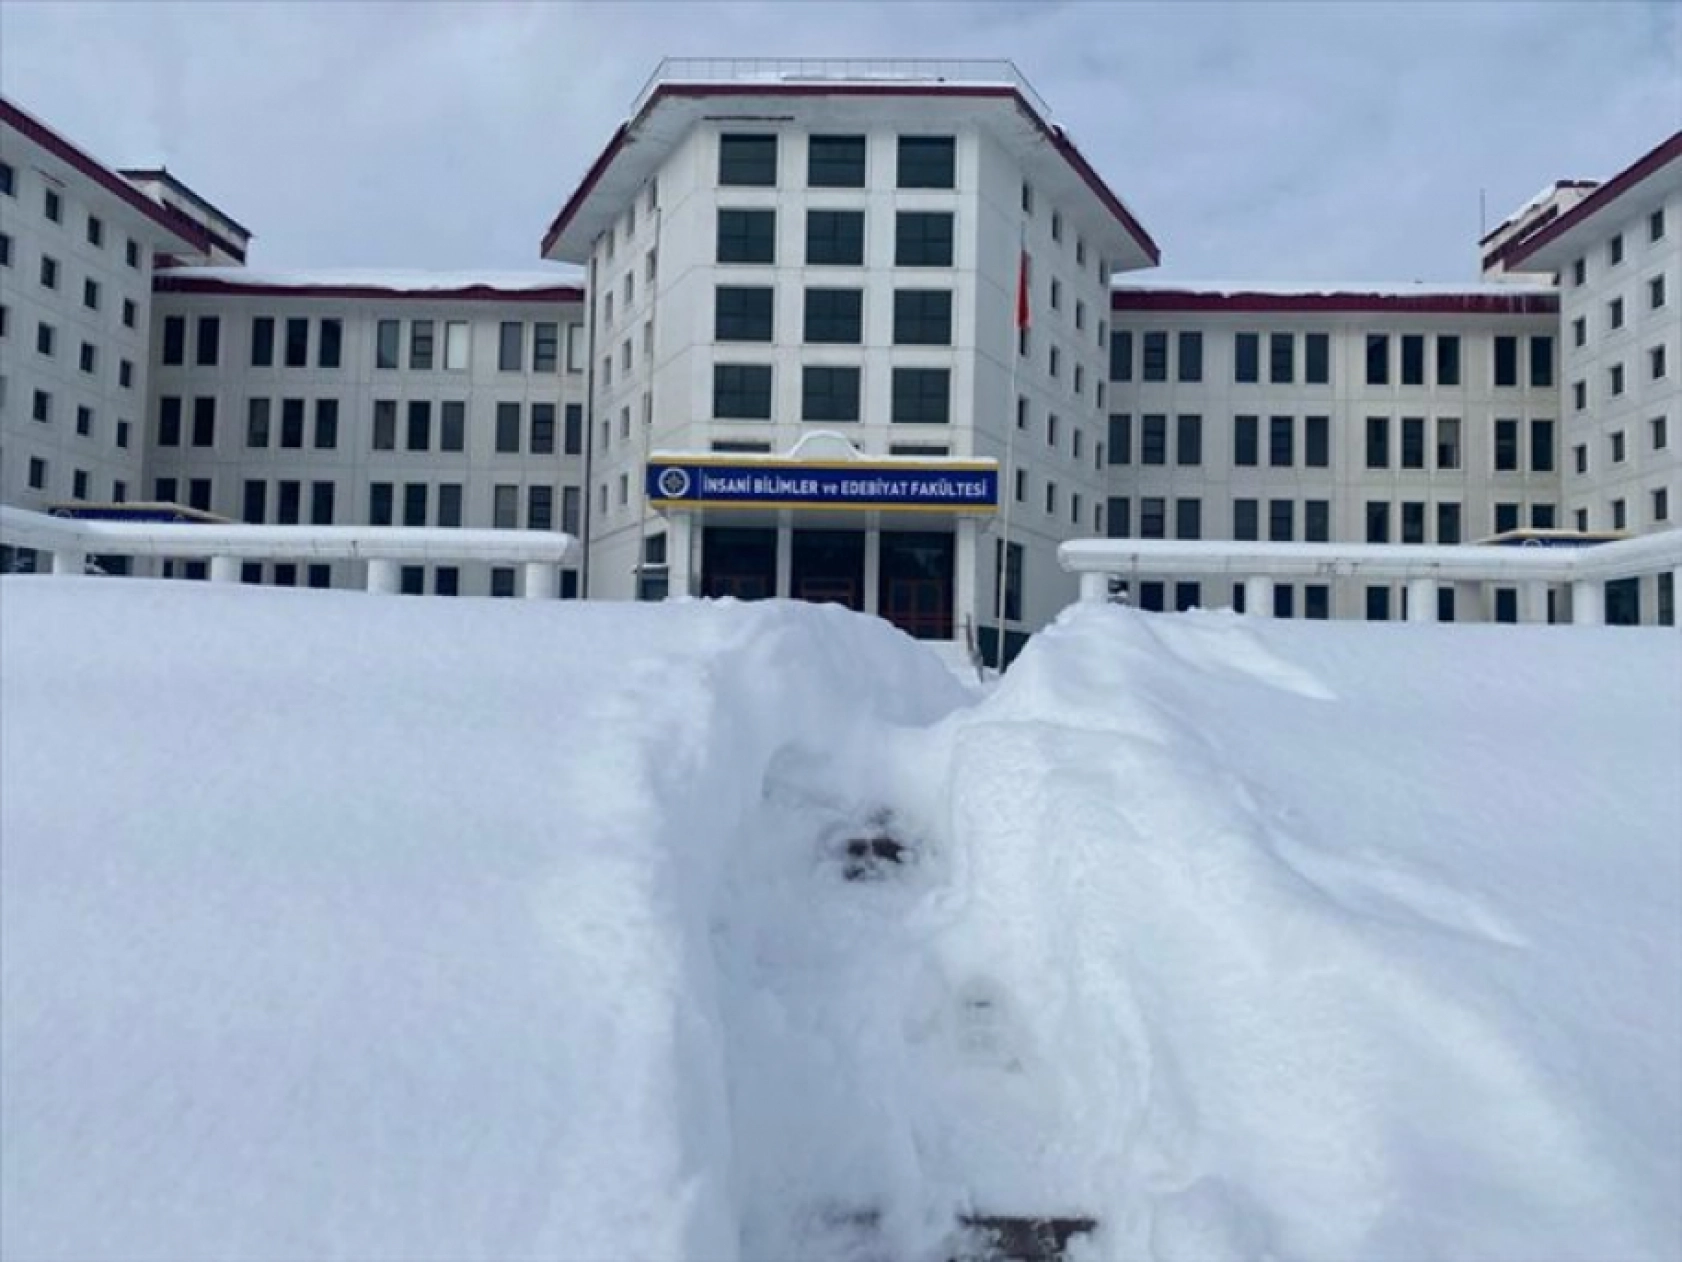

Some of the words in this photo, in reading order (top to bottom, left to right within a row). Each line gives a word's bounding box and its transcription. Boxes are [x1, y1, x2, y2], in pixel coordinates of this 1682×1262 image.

[703, 474, 751, 493] İNSANİ
[754, 475, 818, 494] BİLİMLER
[822, 482, 839, 495] ve
[841, 478, 908, 496] EDEBİYAT
[911, 478, 986, 496] FAKÜLTESİ
